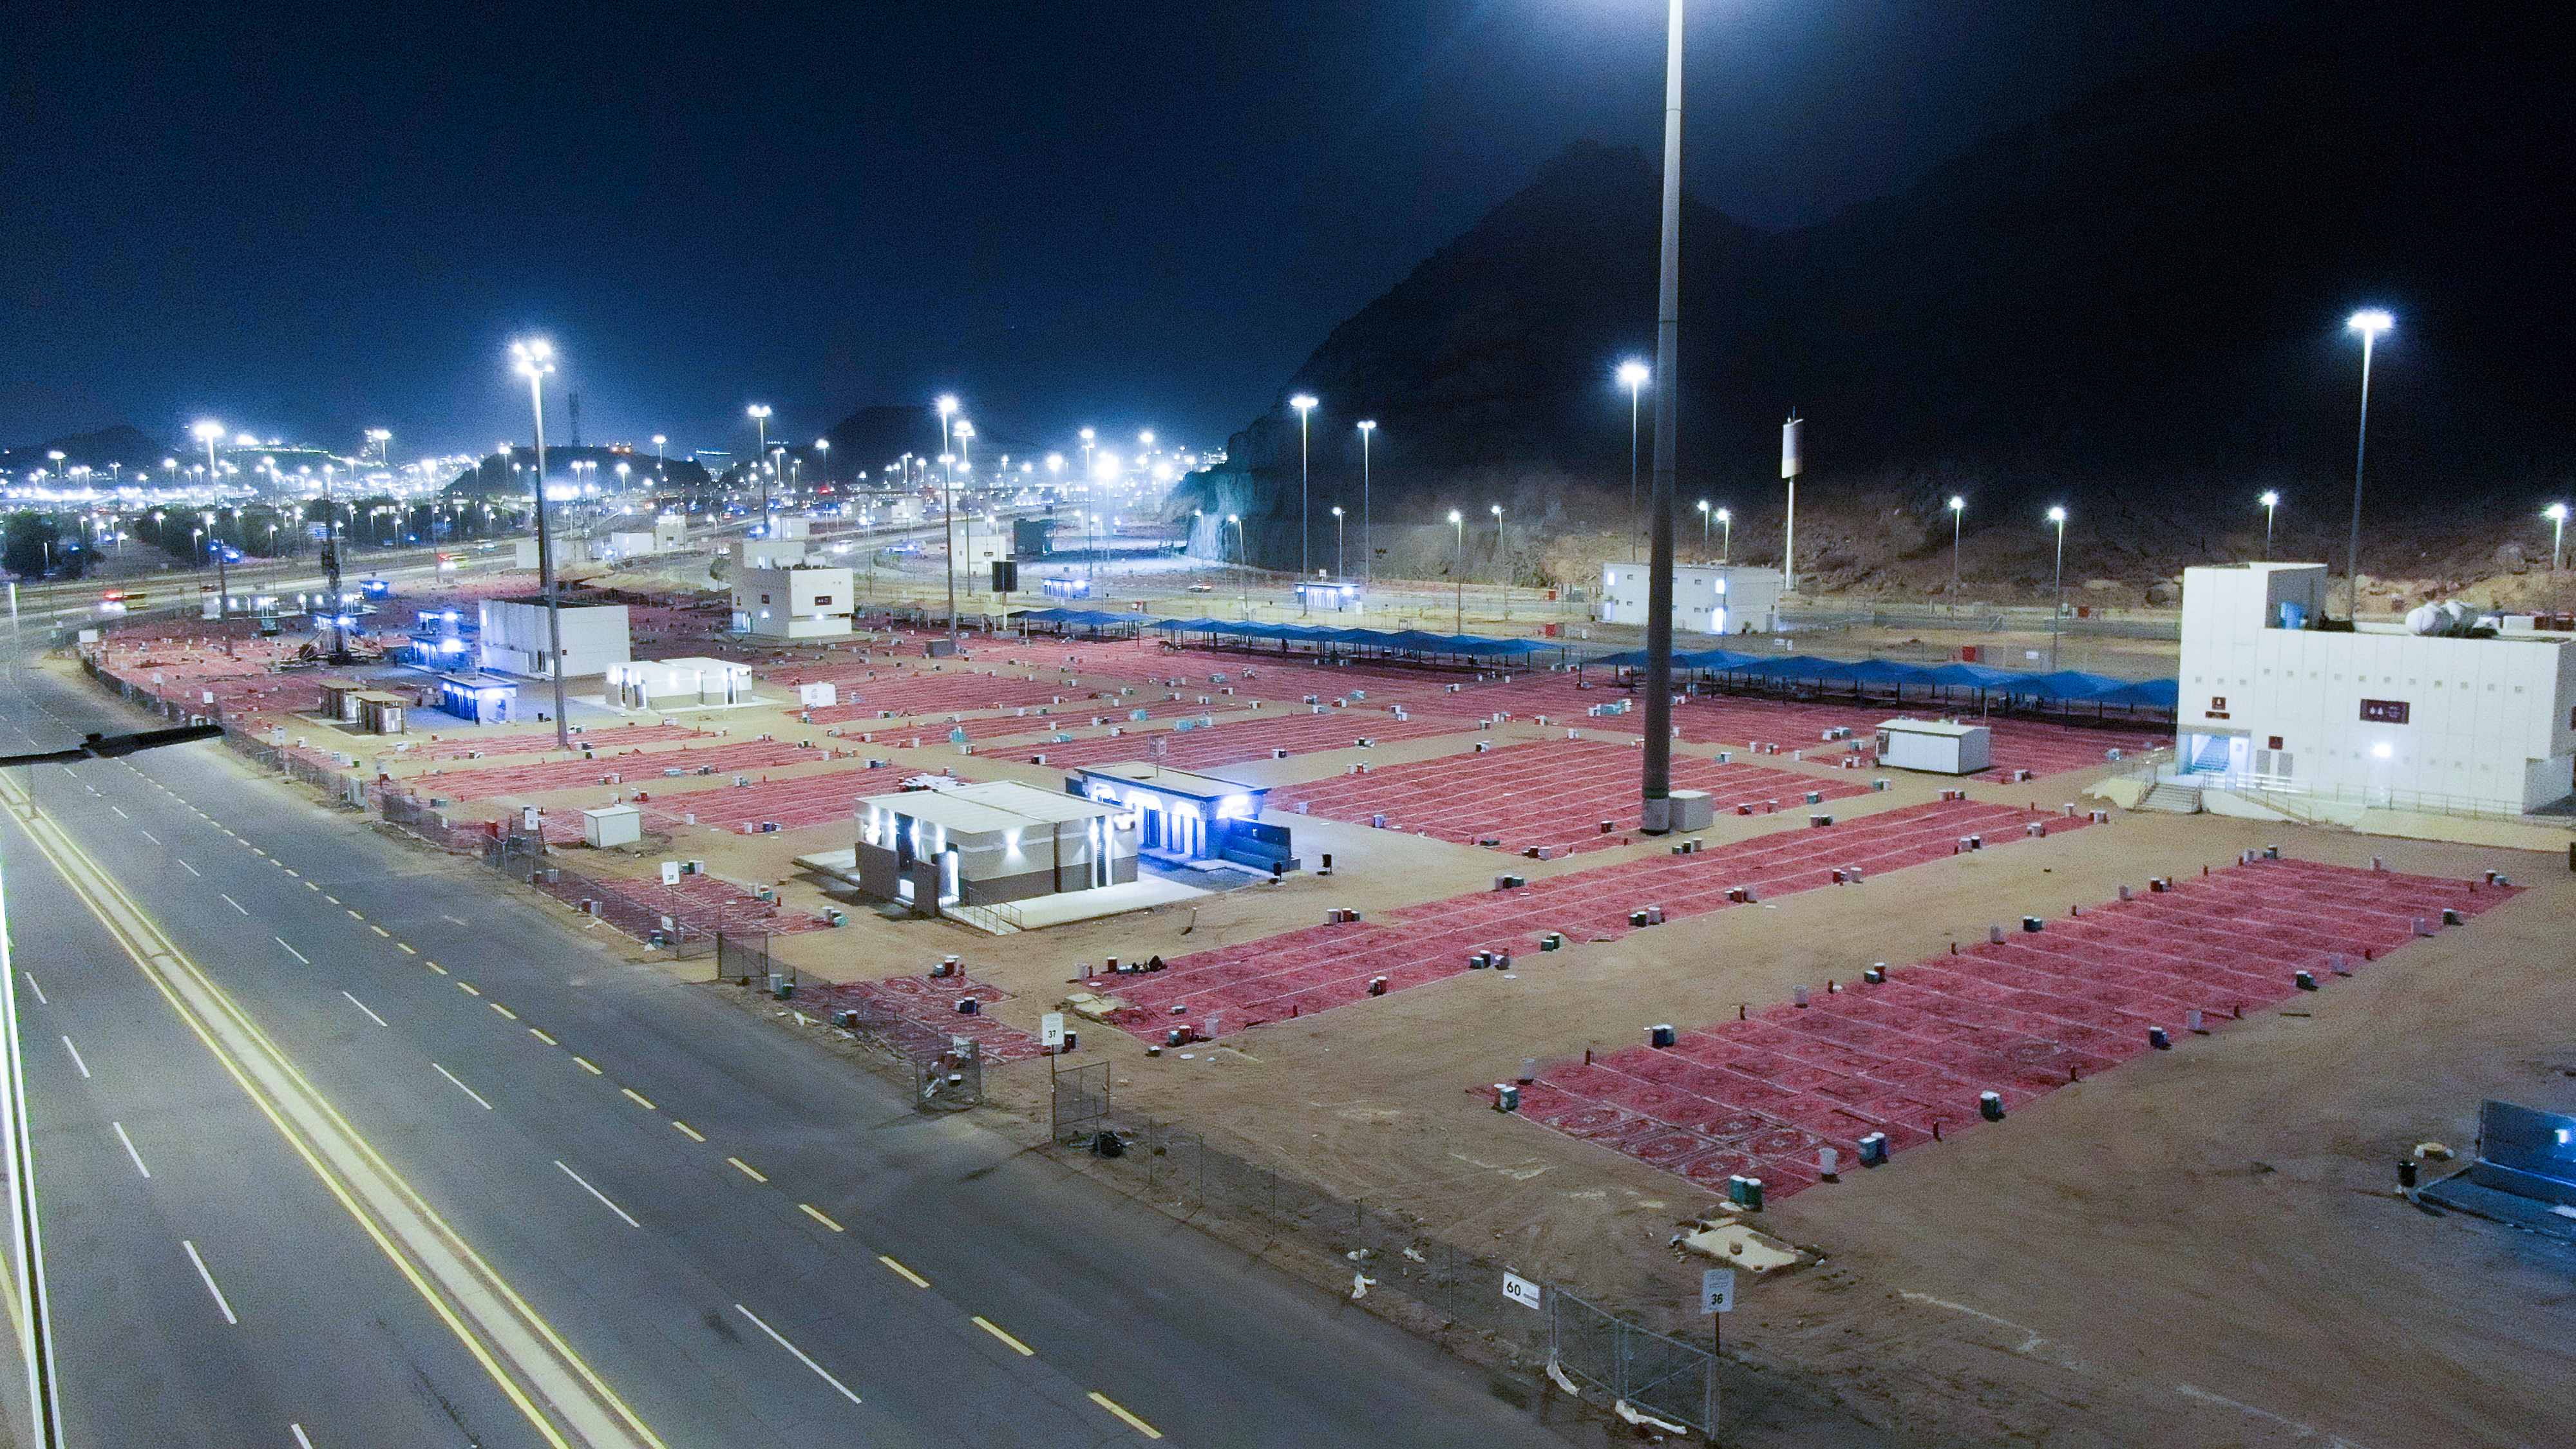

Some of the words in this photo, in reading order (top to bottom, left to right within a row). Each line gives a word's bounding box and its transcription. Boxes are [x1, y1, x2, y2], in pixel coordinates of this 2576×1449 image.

[1048, 1030, 1056, 1038] 37
[1507, 1281, 1521, 1296] 60
[1711, 1293, 1723, 1305] 36
